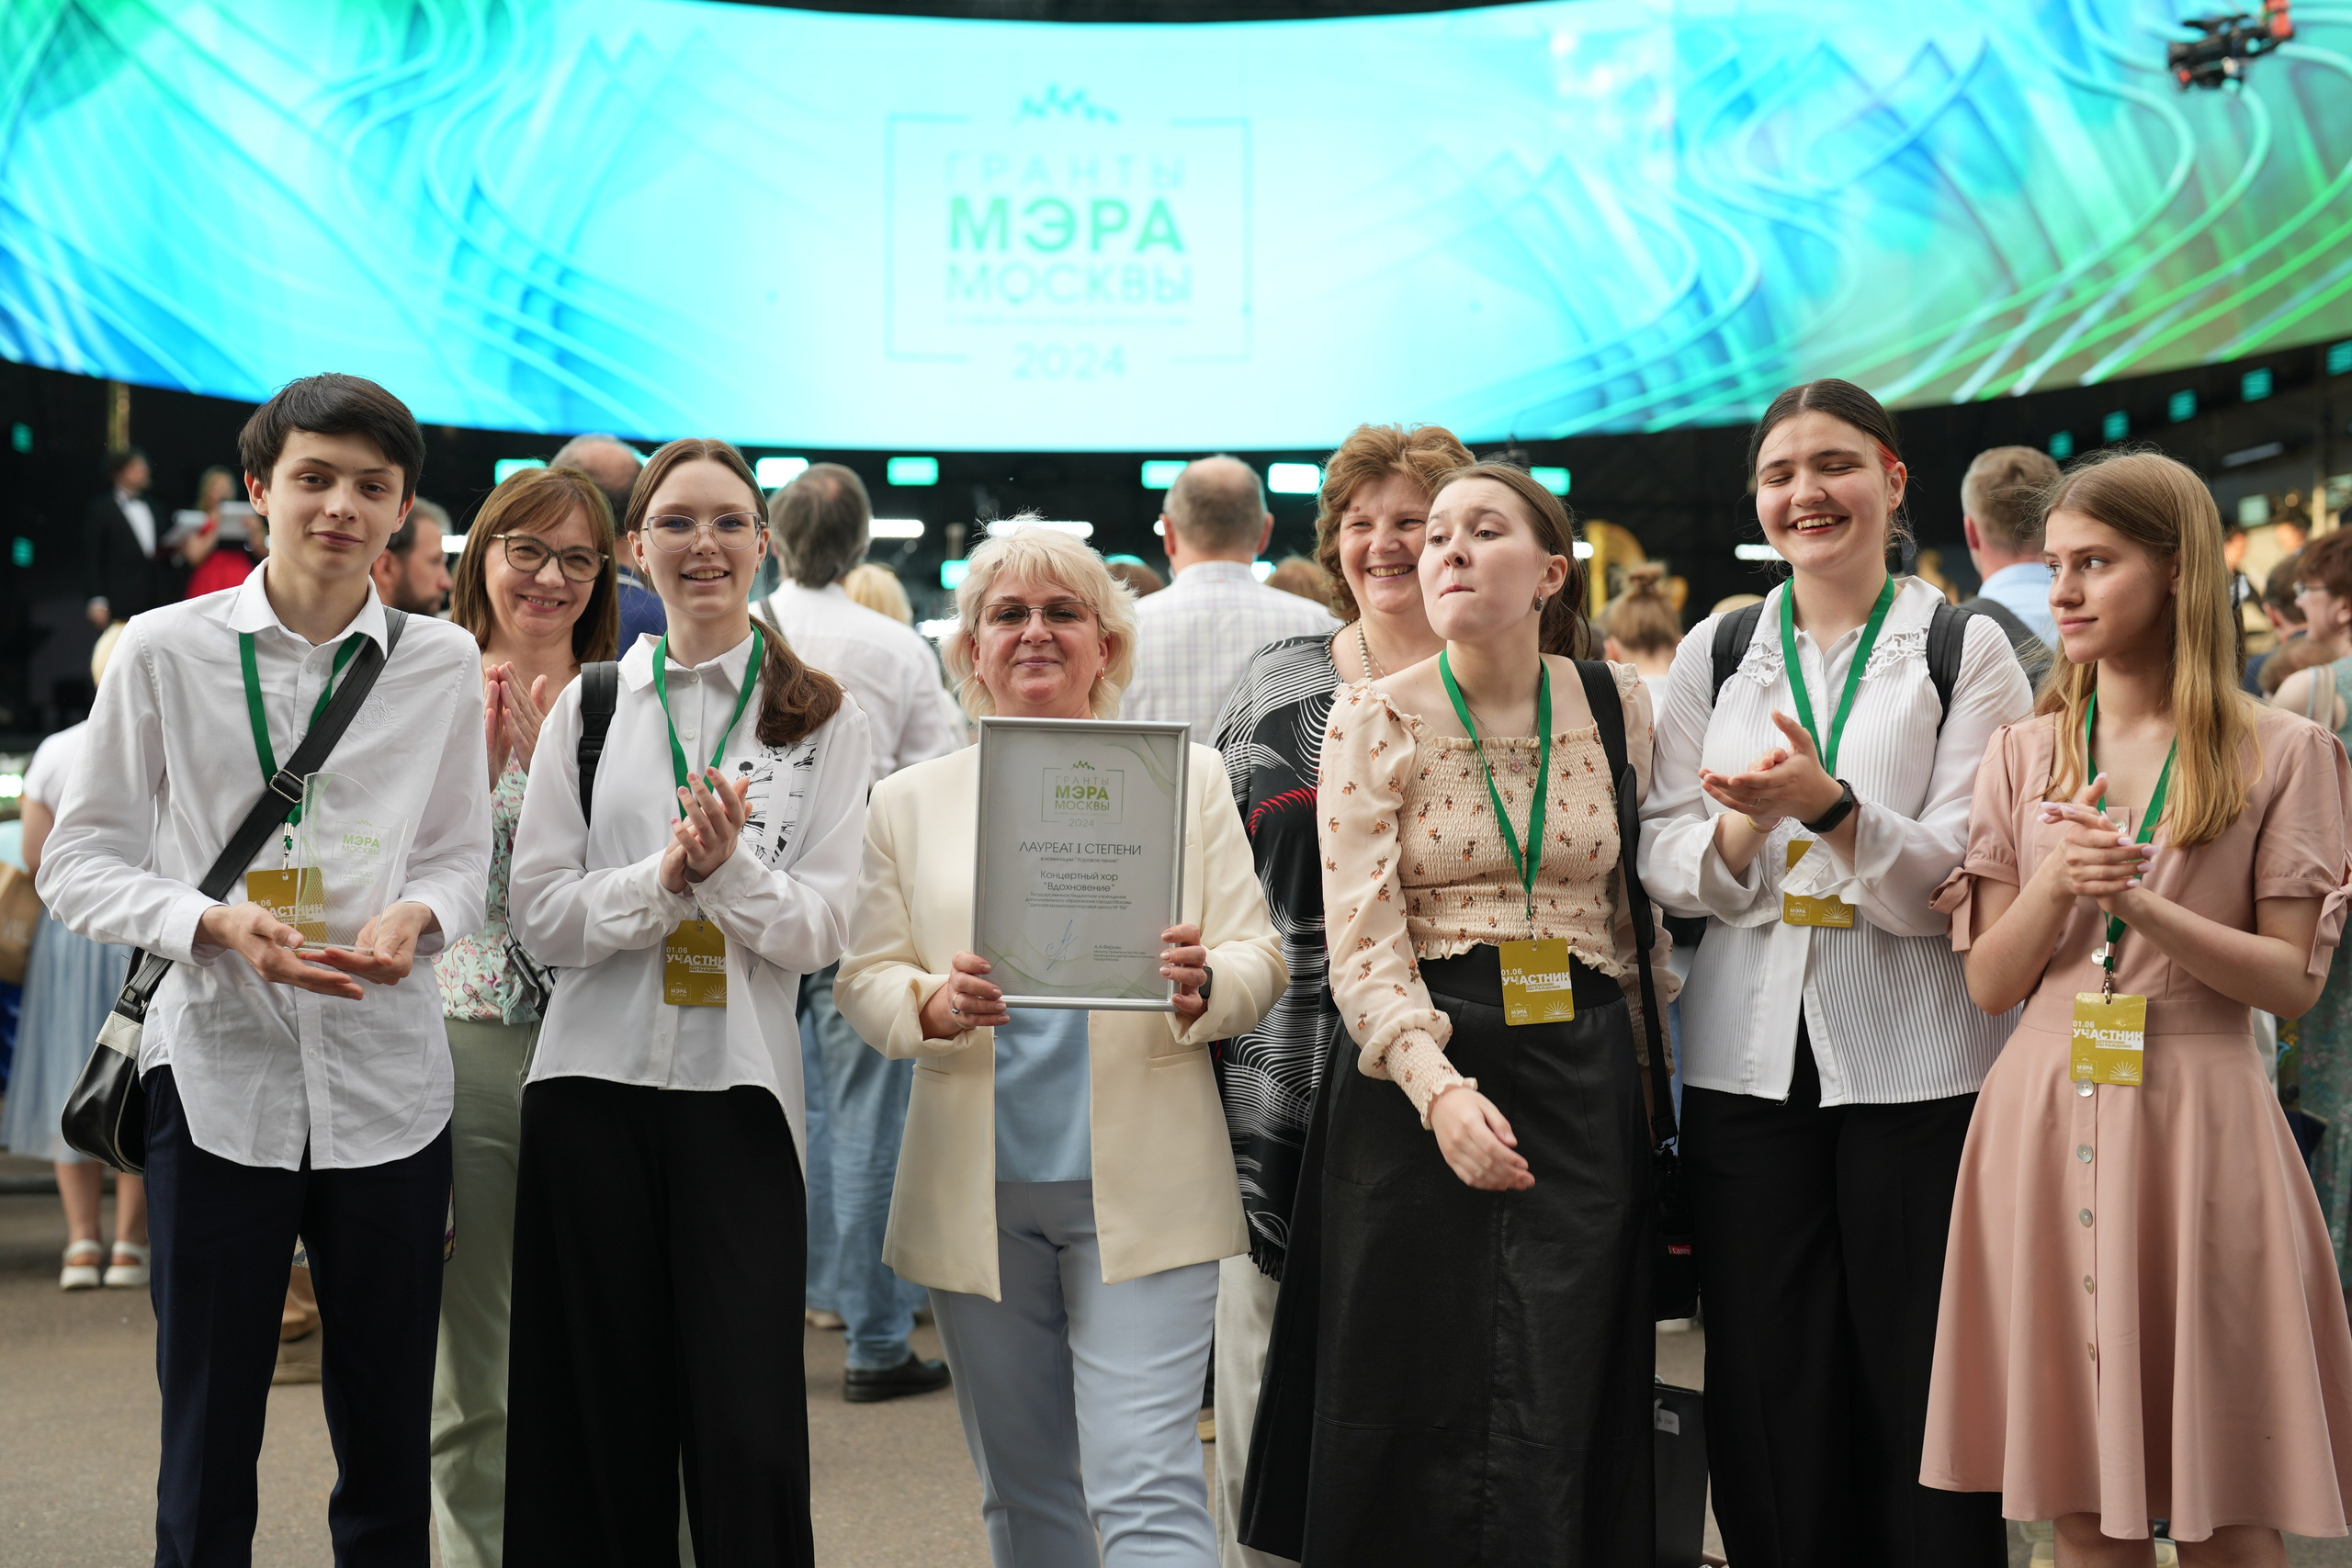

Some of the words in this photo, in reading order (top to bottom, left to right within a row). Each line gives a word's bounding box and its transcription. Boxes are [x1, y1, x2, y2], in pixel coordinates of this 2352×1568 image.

[945, 151, 1185, 189] ГРАНТЫ
[949, 196, 1186, 254] МЭРА
[944, 262, 1192, 304] МОСКВЫ
[1013, 344, 1127, 380] 2024
[1056, 775, 1110, 785] ГРАНТЫ
[1055, 784, 1110, 800] МЭРА
[1055, 800, 1110, 811] МОСКВЫ
[1069, 818, 1094, 827] 2024
[343, 834, 380, 848] МЭРА
[341, 845, 380, 856] МОСКВЫ
[1019, 841, 1074, 853] ЛАУРЕАТ
[1084, 842, 1141, 855] СТЕПЕНИ
[342, 869, 374, 878] ЛАУРЕАТ
[1040, 870, 1099, 881] Концертный
[1101, 874, 1119, 882] хор
[343, 875, 374, 886] СТЕПЕНИ
[1044, 882, 1115, 892] "Вдохновение"
[269, 904, 324, 917] АСТНИК
[666, 954, 726, 965] УЧАСТНИ
[1502, 972, 1570, 986] УЧАСТНИК
[2073, 1029, 2143, 1041] УЧАСТНИК
